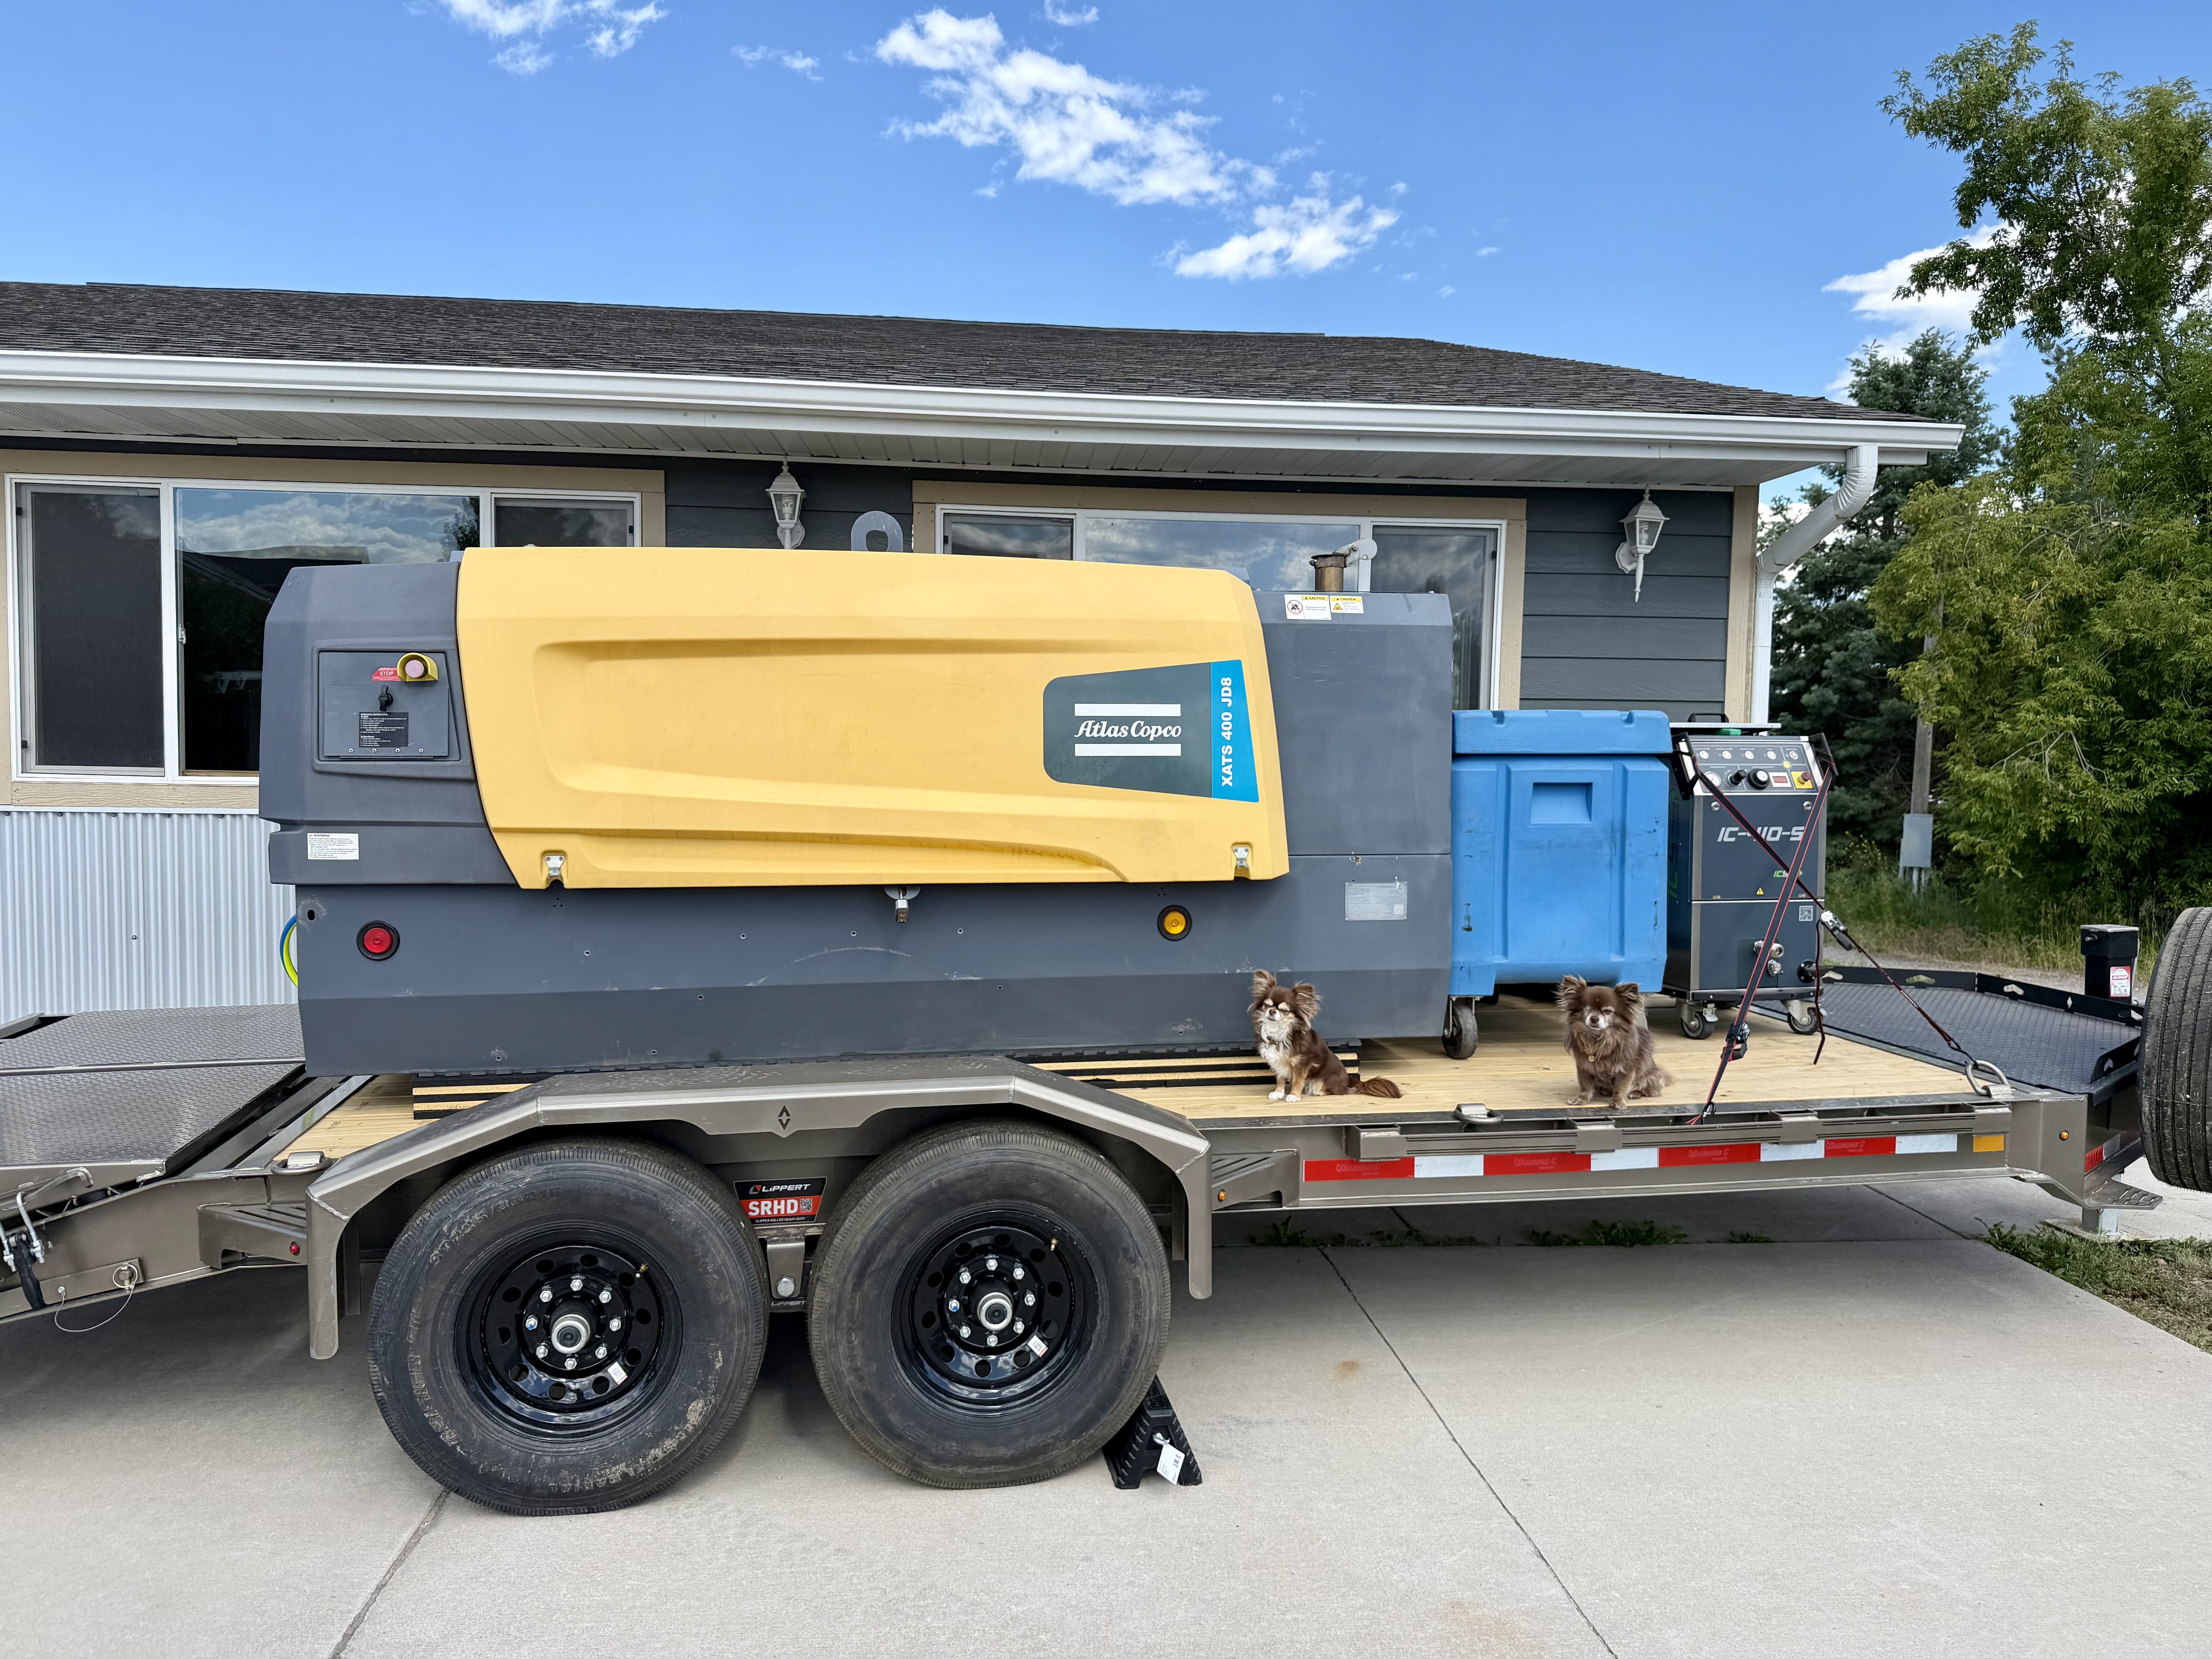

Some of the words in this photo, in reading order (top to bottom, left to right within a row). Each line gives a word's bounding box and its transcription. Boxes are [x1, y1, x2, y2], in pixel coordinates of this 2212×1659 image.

[1220, 676, 1232, 708] JD8
[1074, 720, 1129, 738] Atlas
[1130, 720, 1182, 740] Copco
[1221, 711, 1232, 740] 400
[1221, 744, 1233, 787] XATS
[748, 1199, 798, 1216] SRHD
